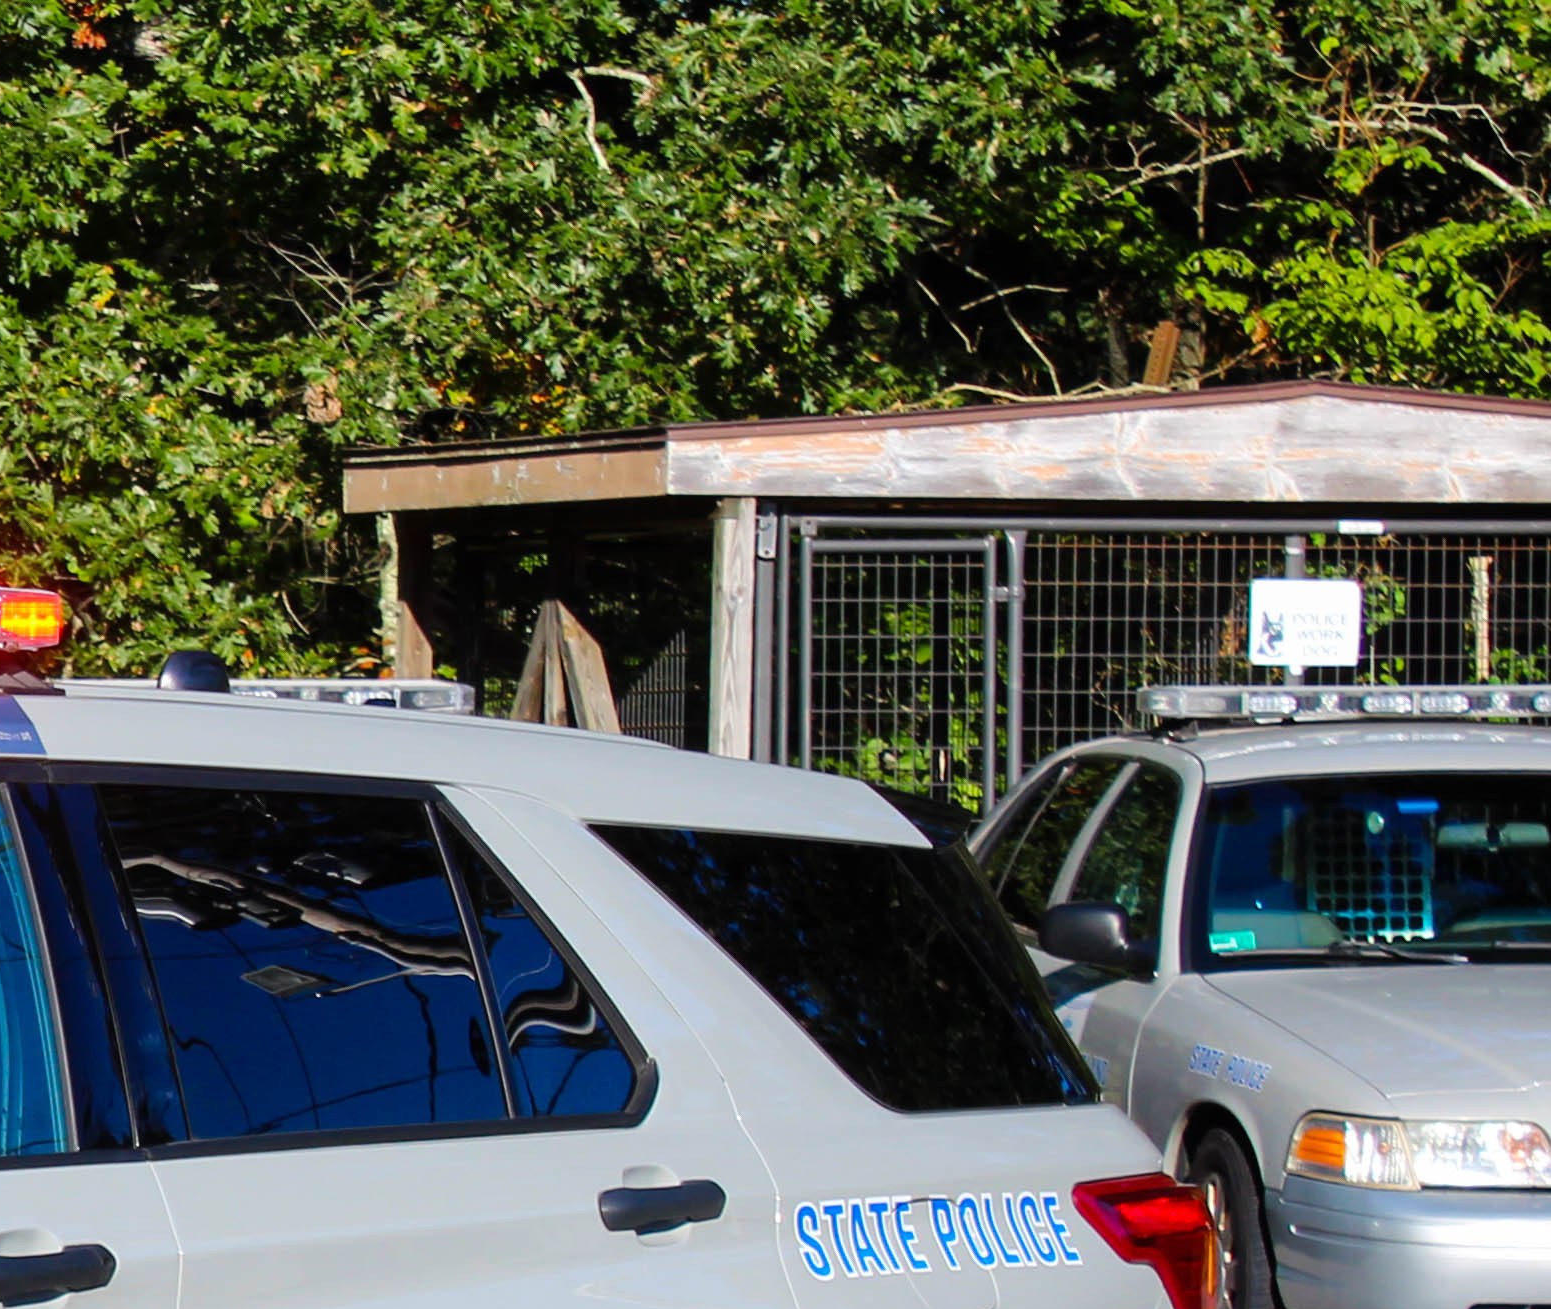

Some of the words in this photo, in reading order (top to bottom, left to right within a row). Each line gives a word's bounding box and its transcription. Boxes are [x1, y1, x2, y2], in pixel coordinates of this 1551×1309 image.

[1292, 612, 1348, 624] POLICE
[1297, 629, 1345, 641] WORK
[1303, 645, 1338, 657] DOG
[1188, 1044, 1226, 1079] STATE
[1227, 1052, 1273, 1093] POLICE
[794, 1195, 933, 1281] STATE
[928, 1191, 1083, 1271] POLICE
